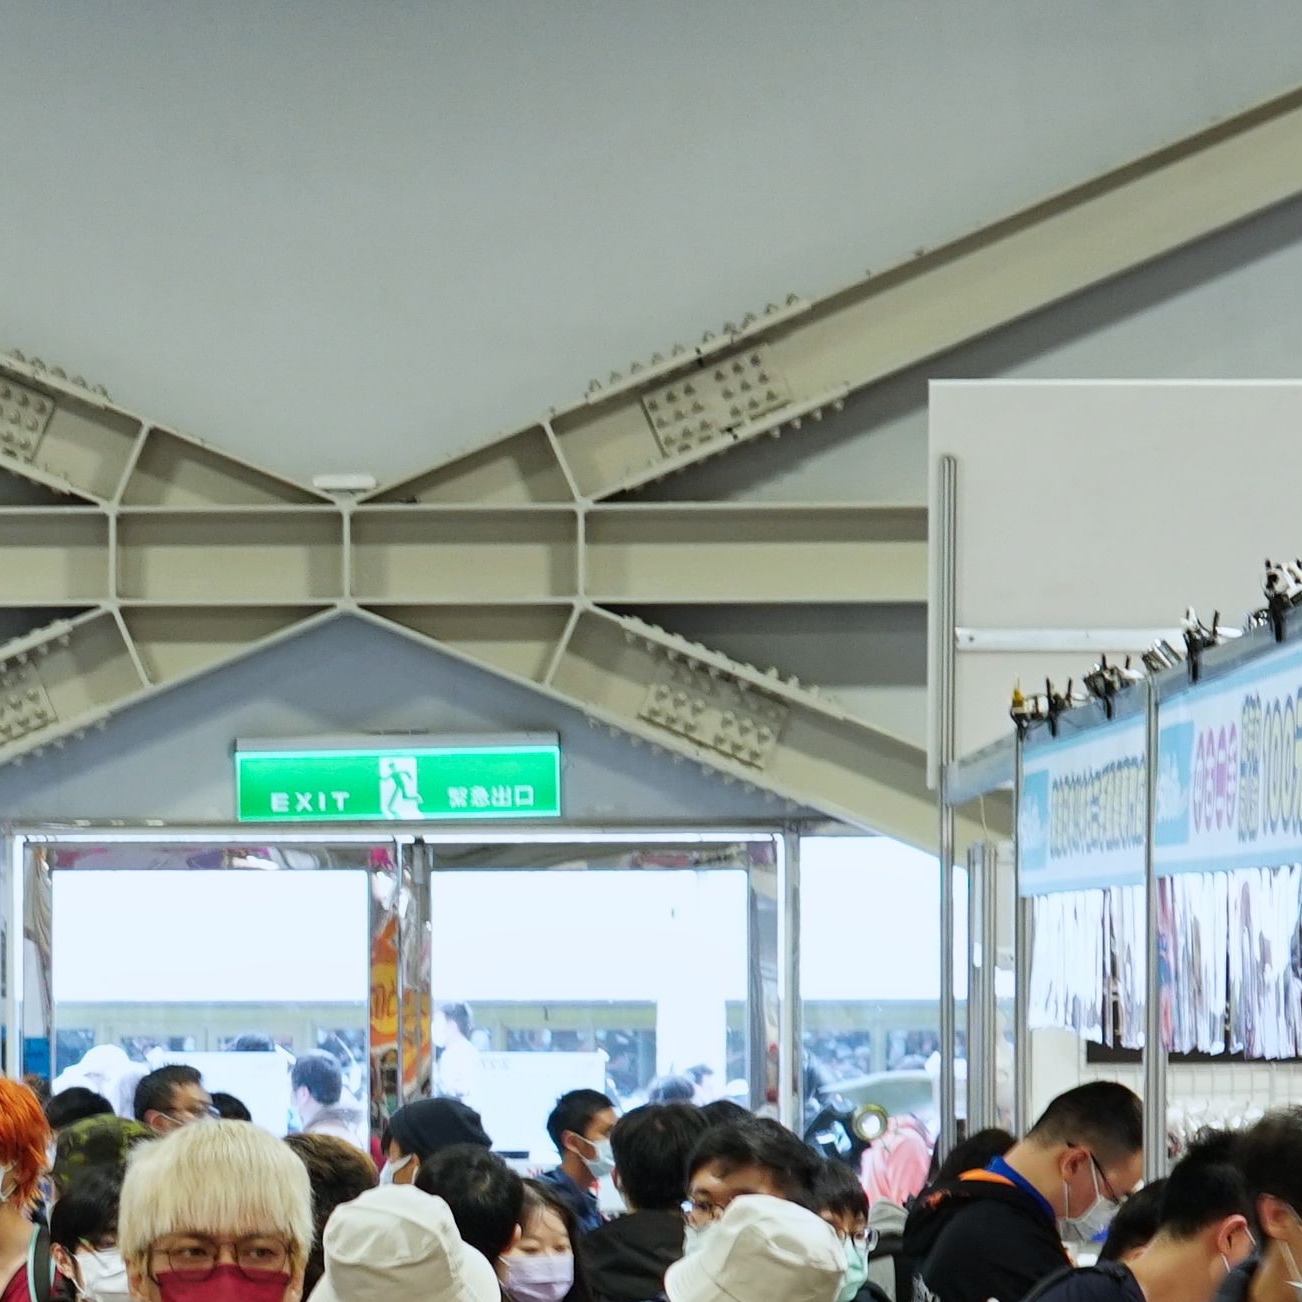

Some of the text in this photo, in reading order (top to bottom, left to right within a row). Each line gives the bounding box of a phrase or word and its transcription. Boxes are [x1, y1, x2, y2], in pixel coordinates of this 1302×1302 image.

[270, 791, 350, 812] EXIT
[447, 785, 534, 808] 緊急出口
